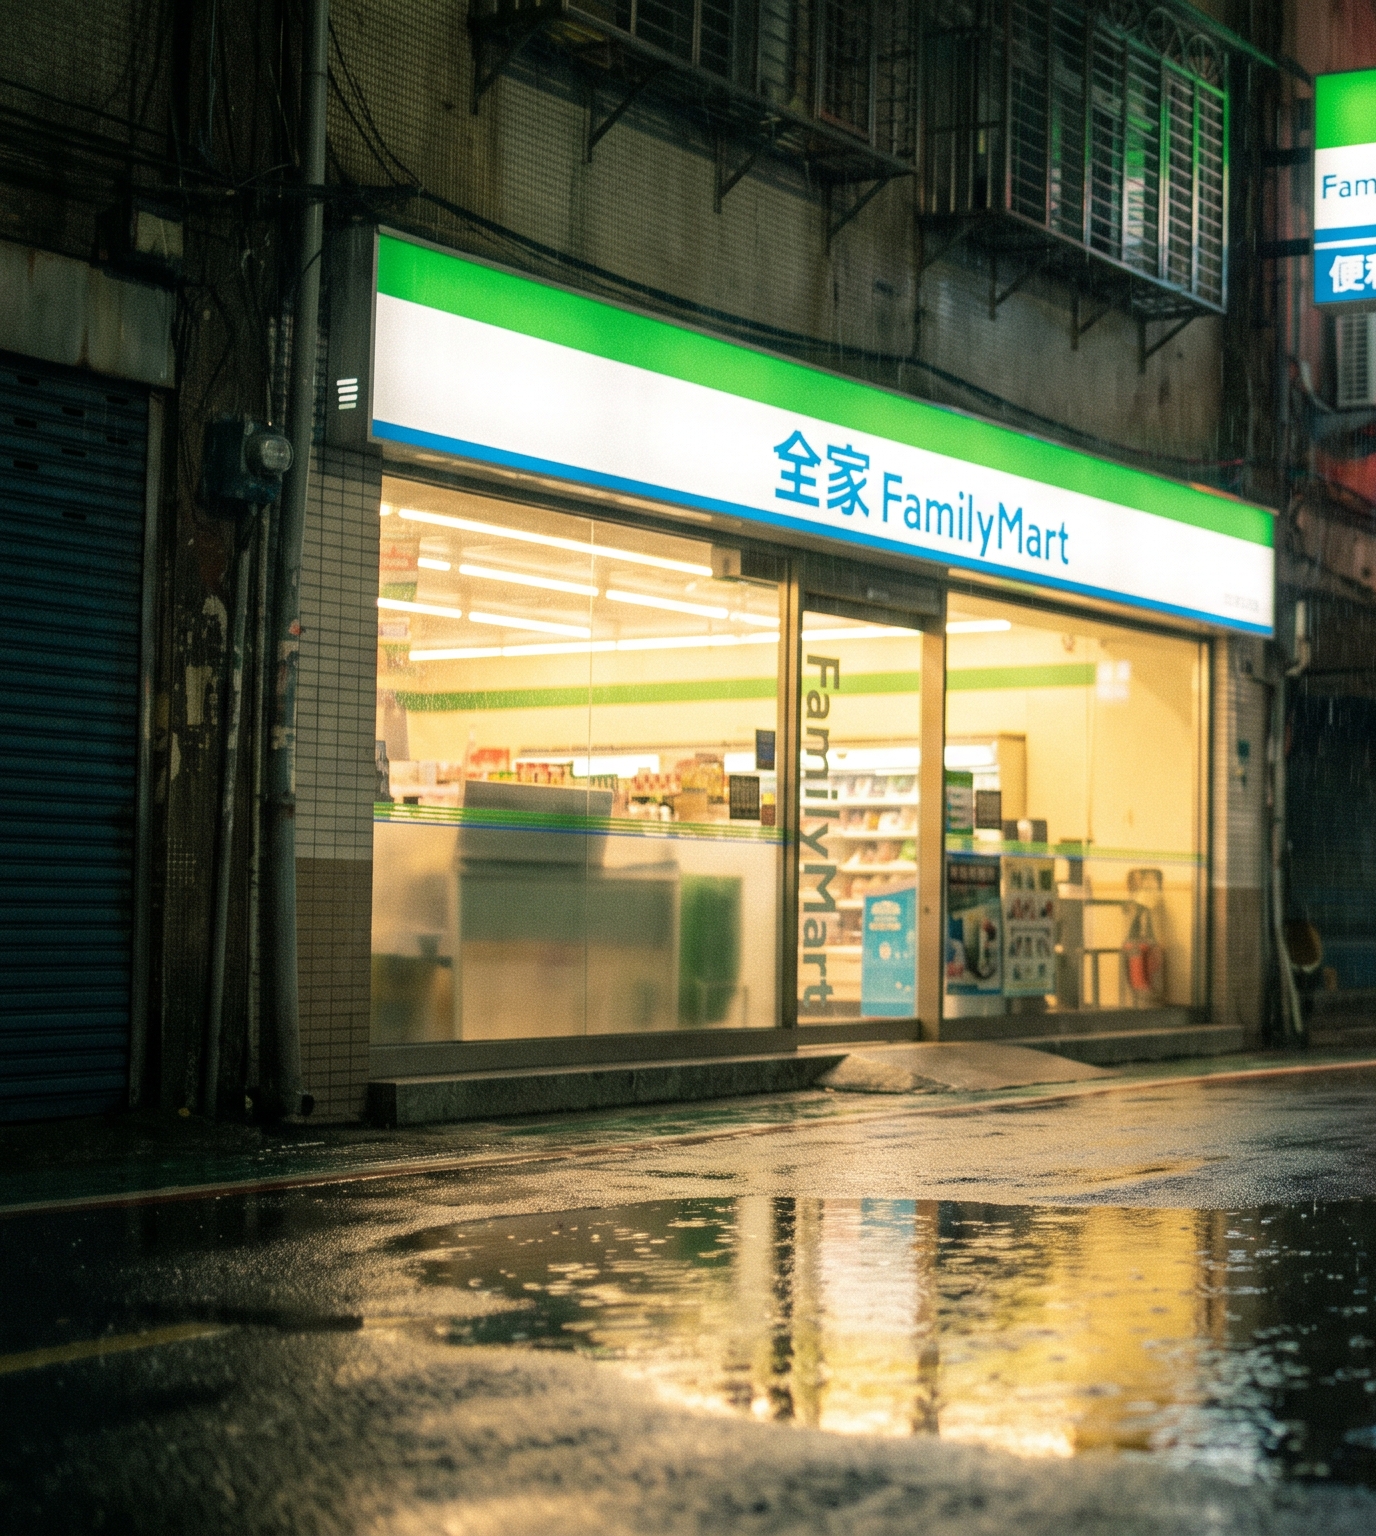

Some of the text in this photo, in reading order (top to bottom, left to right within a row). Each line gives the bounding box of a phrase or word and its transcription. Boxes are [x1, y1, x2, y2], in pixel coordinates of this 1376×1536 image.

[773, 429, 1070, 565] 全家 FamilyMart
[800, 654, 840, 1007] FamilyMart
